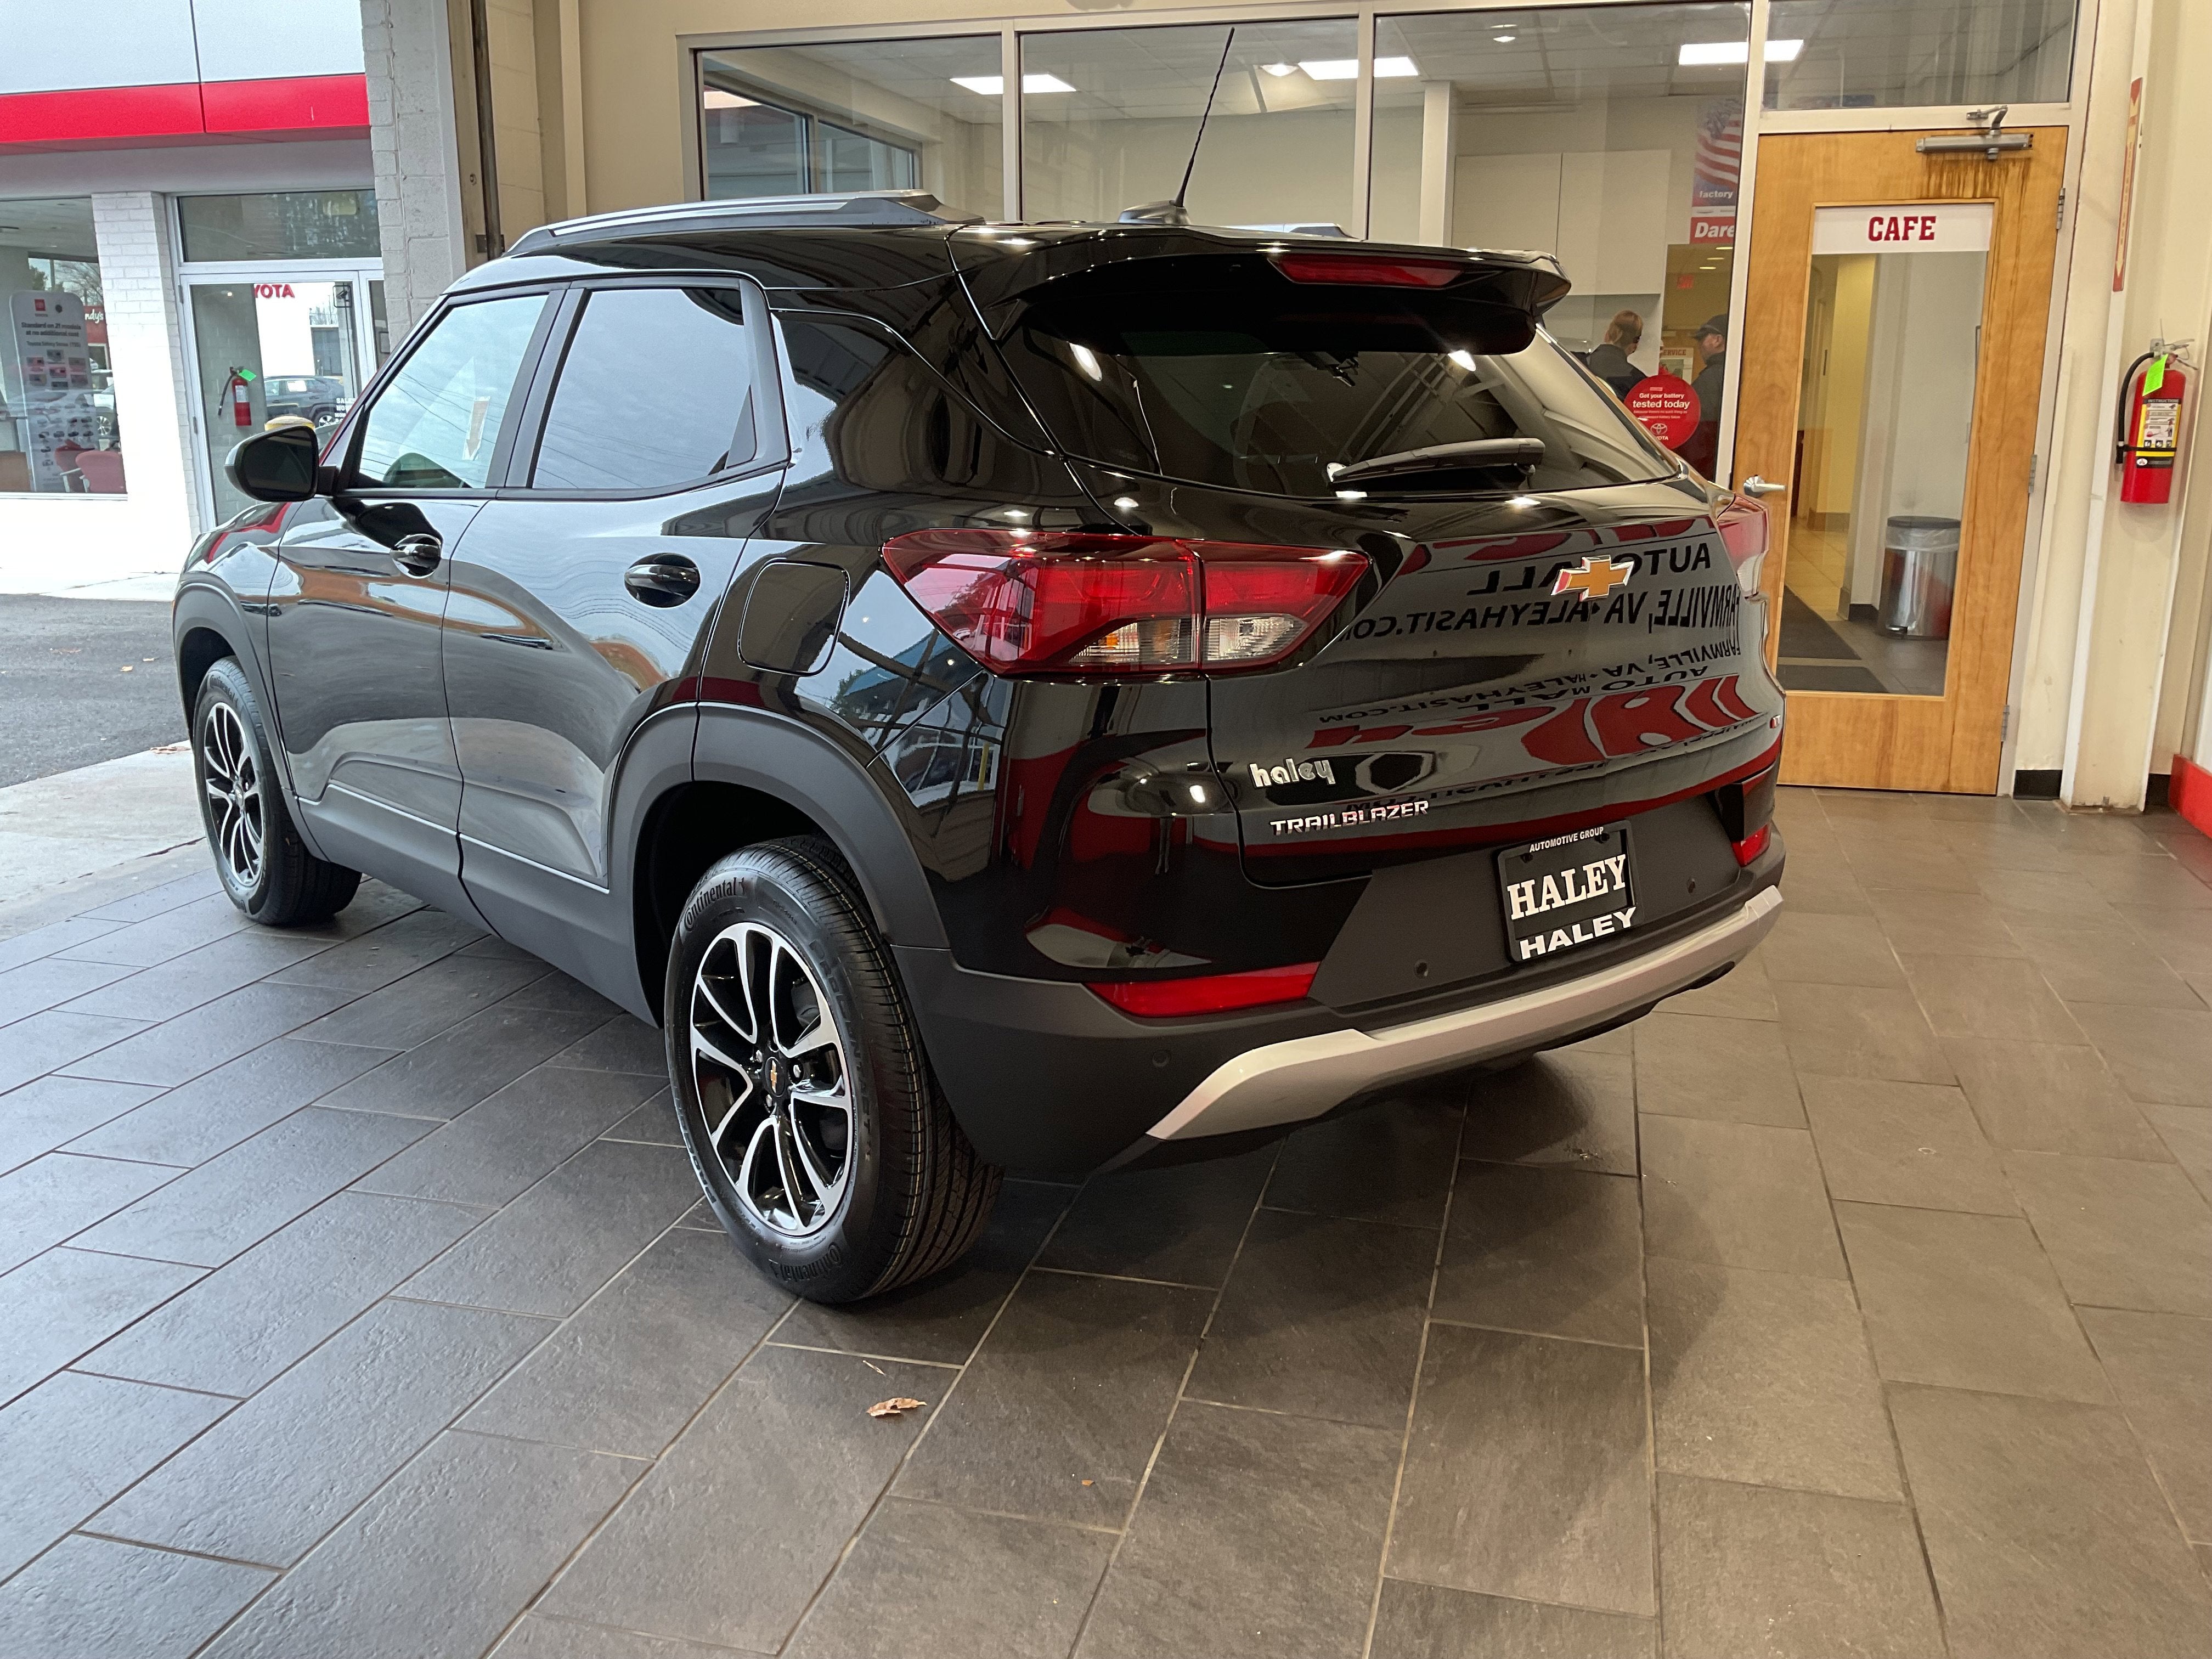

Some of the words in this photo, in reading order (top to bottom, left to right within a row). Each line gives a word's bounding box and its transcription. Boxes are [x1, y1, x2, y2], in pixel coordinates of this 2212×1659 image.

[1868, 216, 1937, 241] CAFE
[254, 284, 295, 298] YOTA
[84, 309, 104, 324] ndy's
[1633, 400, 1662, 408] tested
[1664, 399, 1690, 410] today
[1249, 757, 1337, 789] haley
[1269, 800, 1430, 836] TRAILBLAZER
[1528, 833, 1579, 853] AUTOMOTIVE
[1579, 826, 1605, 840] GROUP
[1506, 854, 1626, 921] HALEY
[684, 876, 737, 932] Continental
[1519, 906, 1637, 961] HALEY
